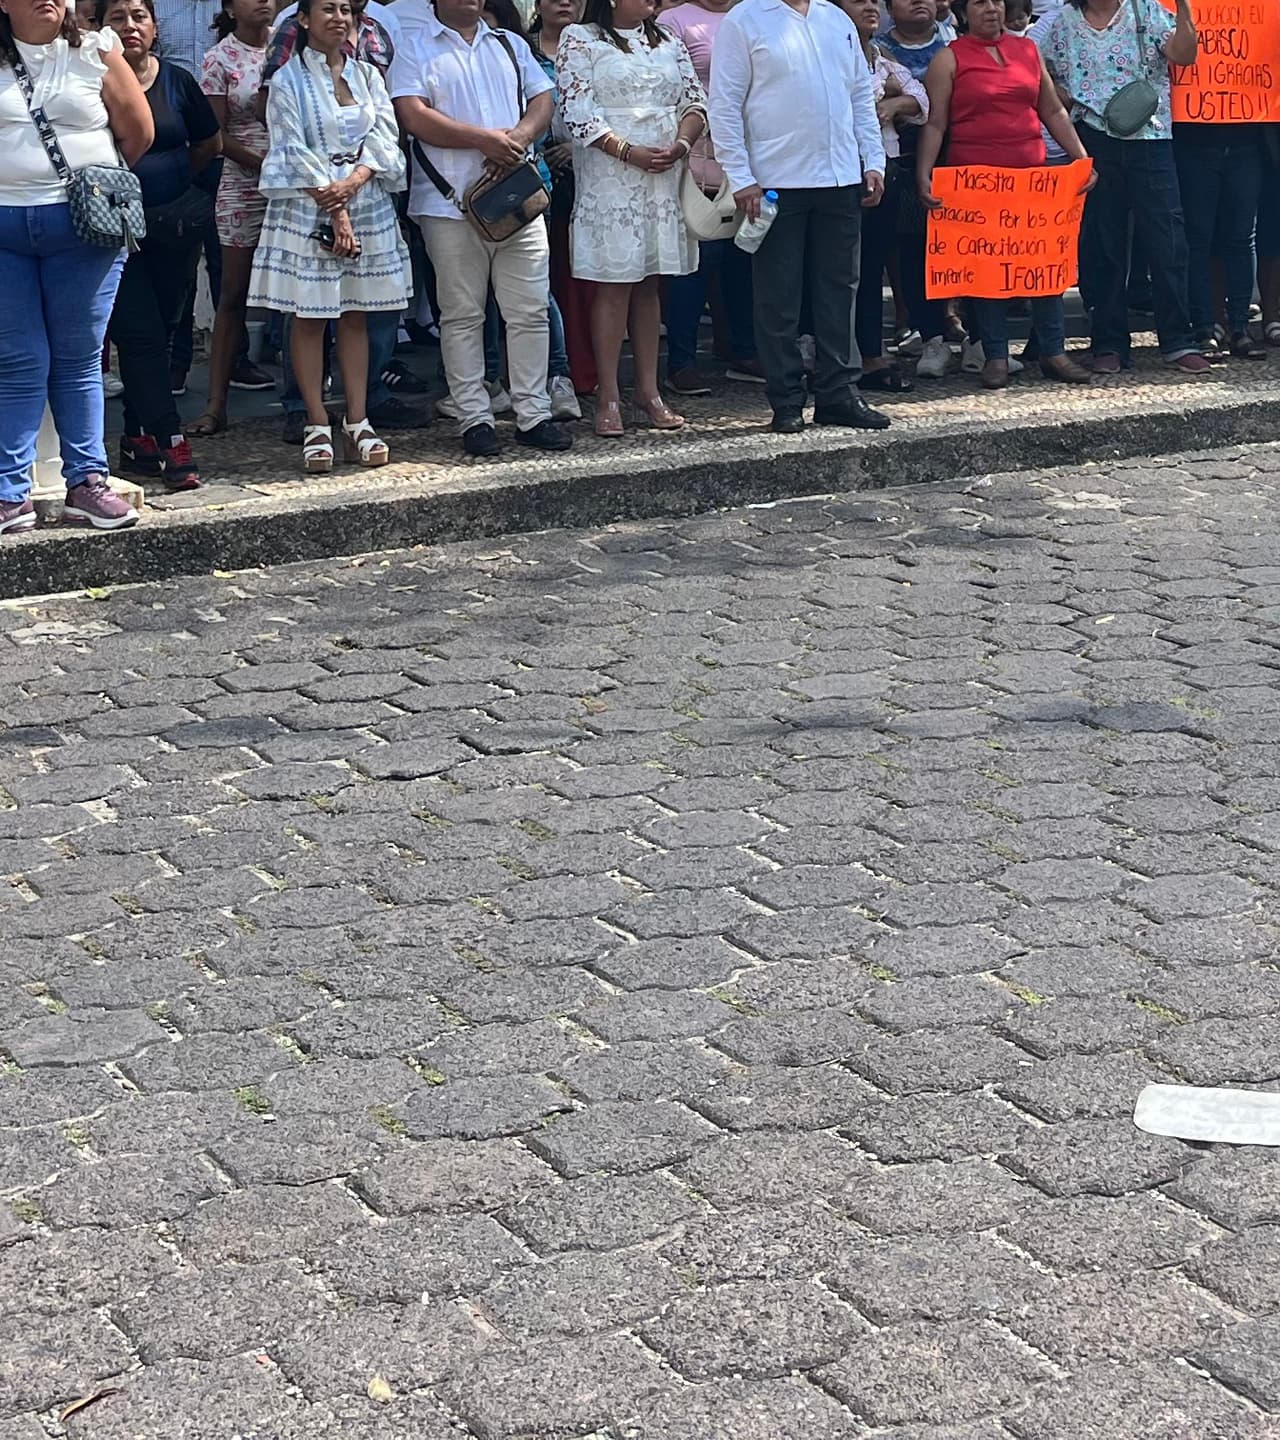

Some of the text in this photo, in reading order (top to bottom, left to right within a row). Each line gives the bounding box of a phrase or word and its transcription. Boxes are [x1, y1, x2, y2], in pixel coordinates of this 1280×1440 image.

[1194, 5, 1245, 25] DUCACION
[1196, 28, 1249, 60] ABASCO
[954, 168, 1058, 198] Maestra Paty
[928, 229, 947, 255] de
